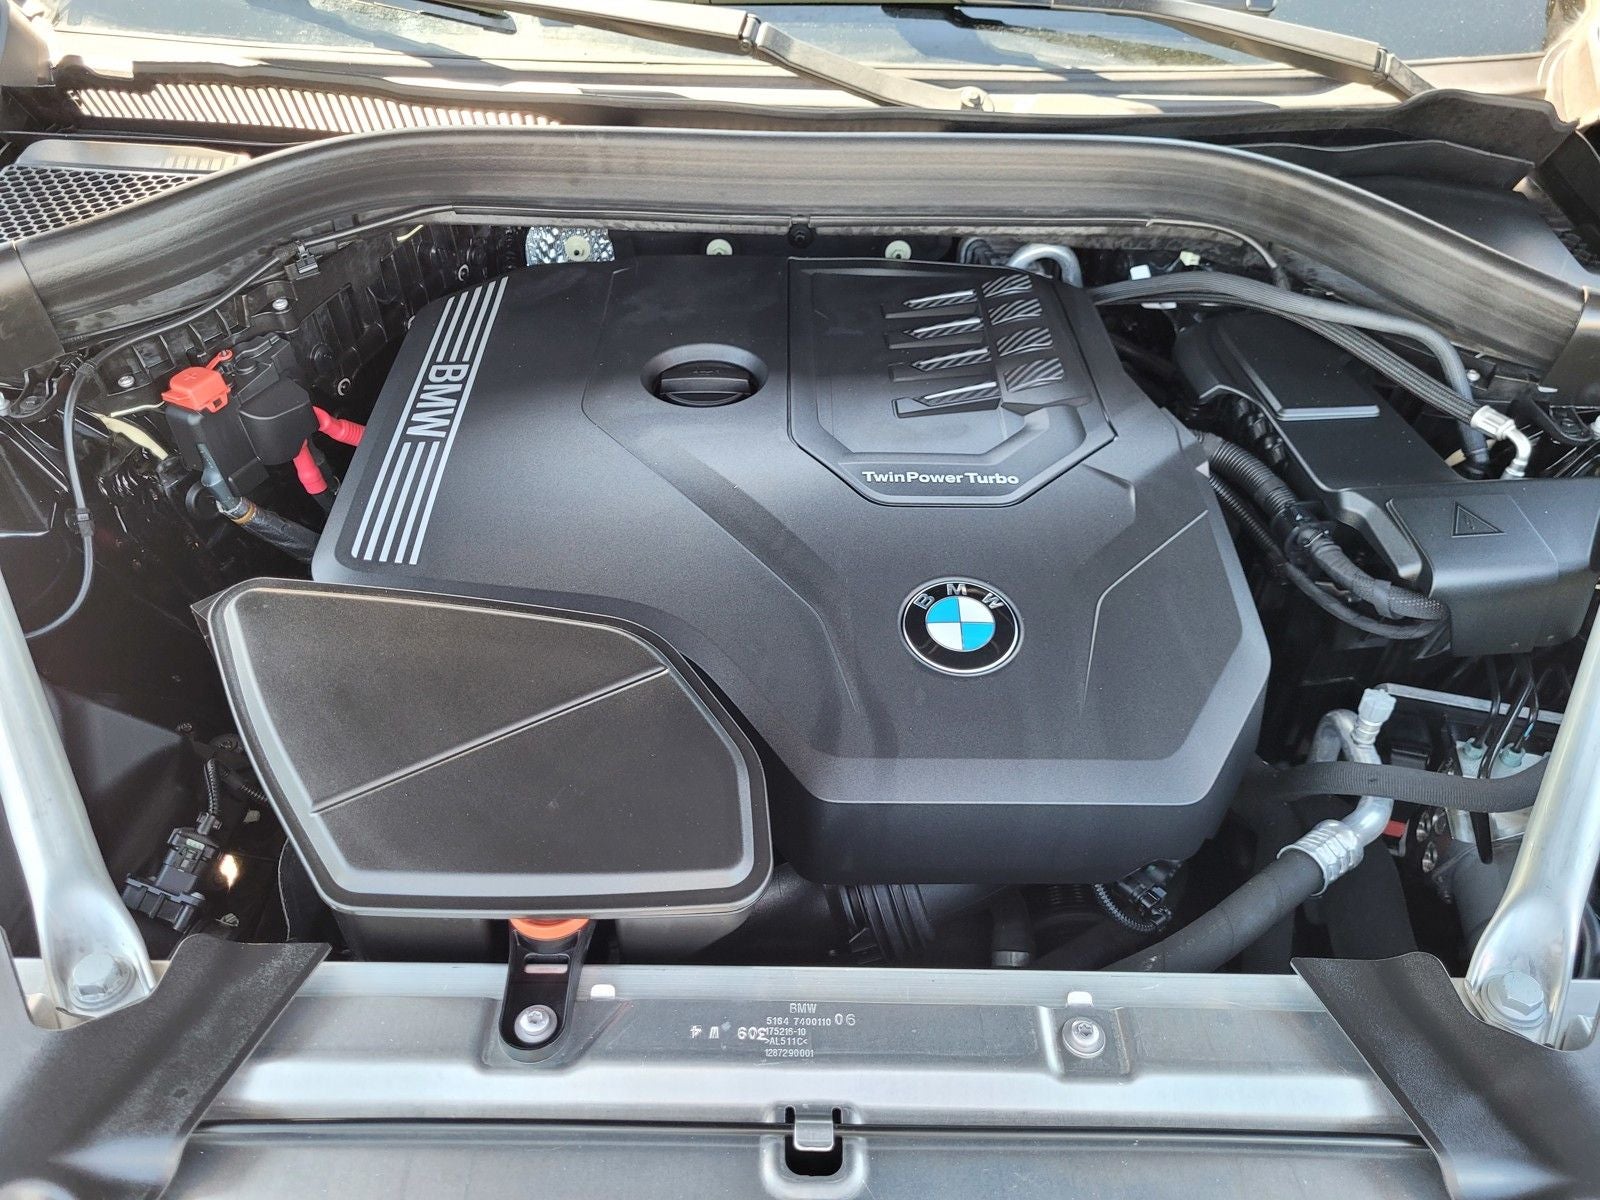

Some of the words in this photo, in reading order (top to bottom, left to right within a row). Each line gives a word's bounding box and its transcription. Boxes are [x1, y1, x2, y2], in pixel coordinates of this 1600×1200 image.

[406, 364, 470, 438] BMW
[964, 472, 1019, 485] Turbo
[913, 583, 1004, 610] BMW
[789, 1002, 817, 1014] BMW
[766, 1016, 789, 1026] 5164
